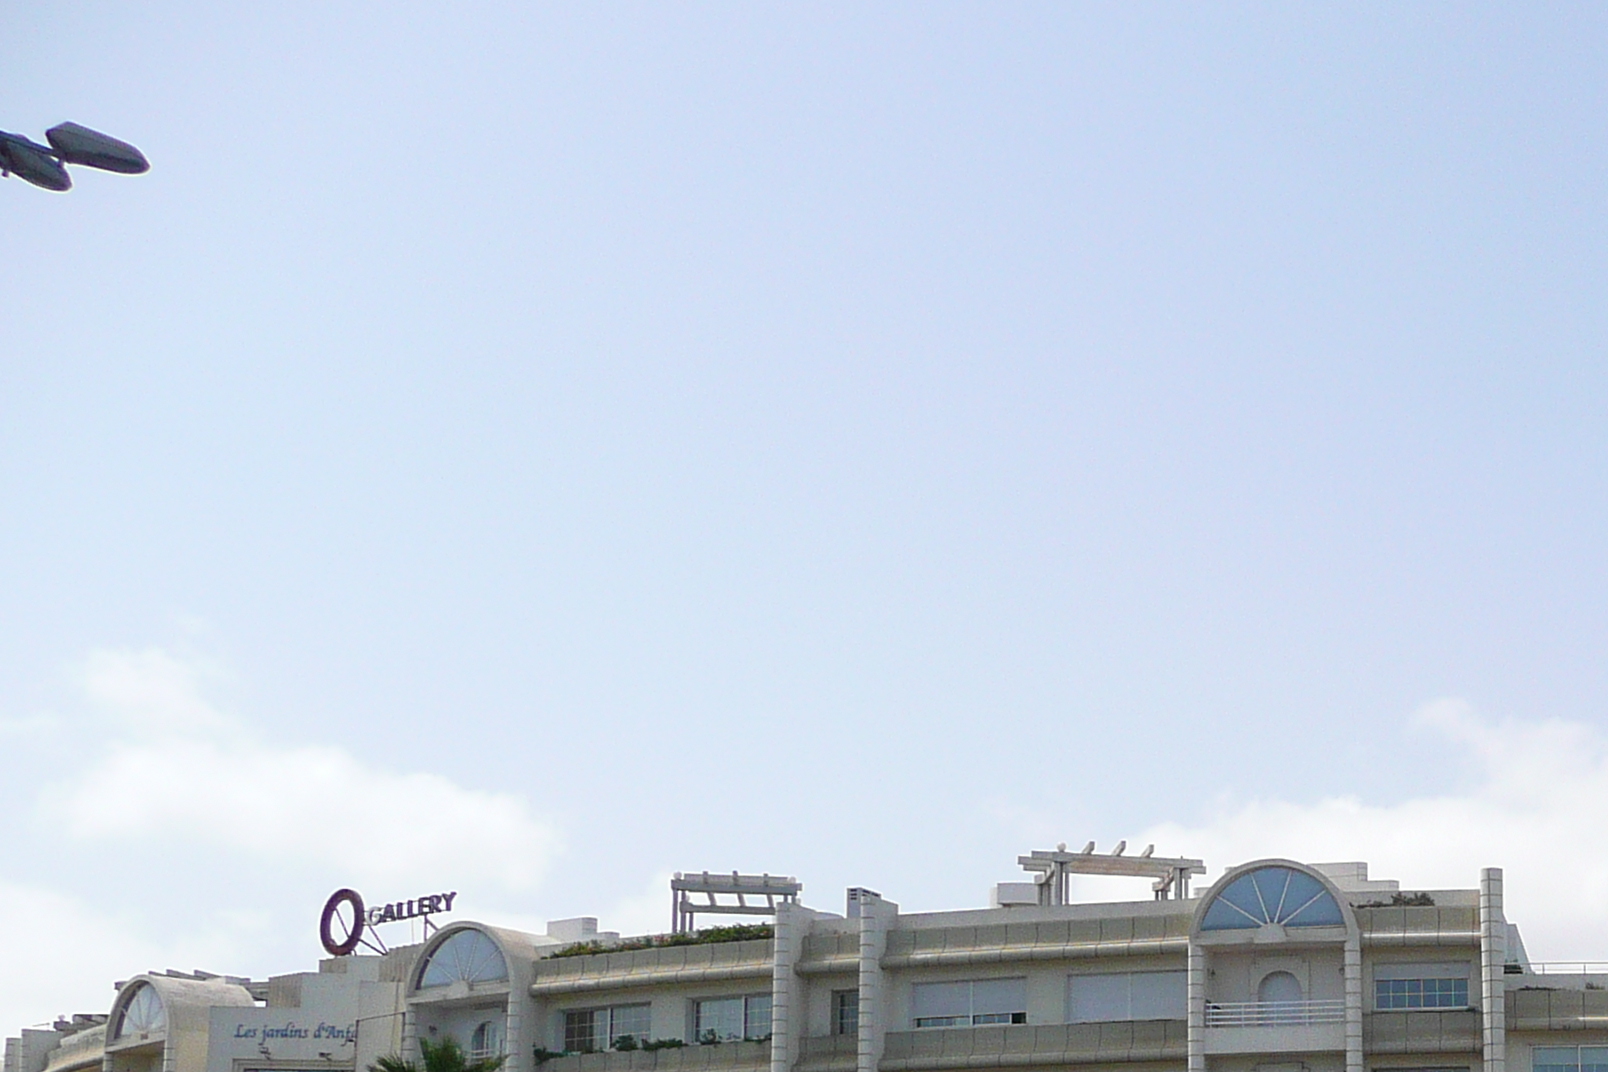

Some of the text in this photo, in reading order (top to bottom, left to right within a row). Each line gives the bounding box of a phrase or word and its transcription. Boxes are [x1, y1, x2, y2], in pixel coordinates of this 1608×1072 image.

[366, 891, 457, 926] GALLERY
[234, 1024, 258, 1038] Les
[258, 1021, 308, 1046] jardins
